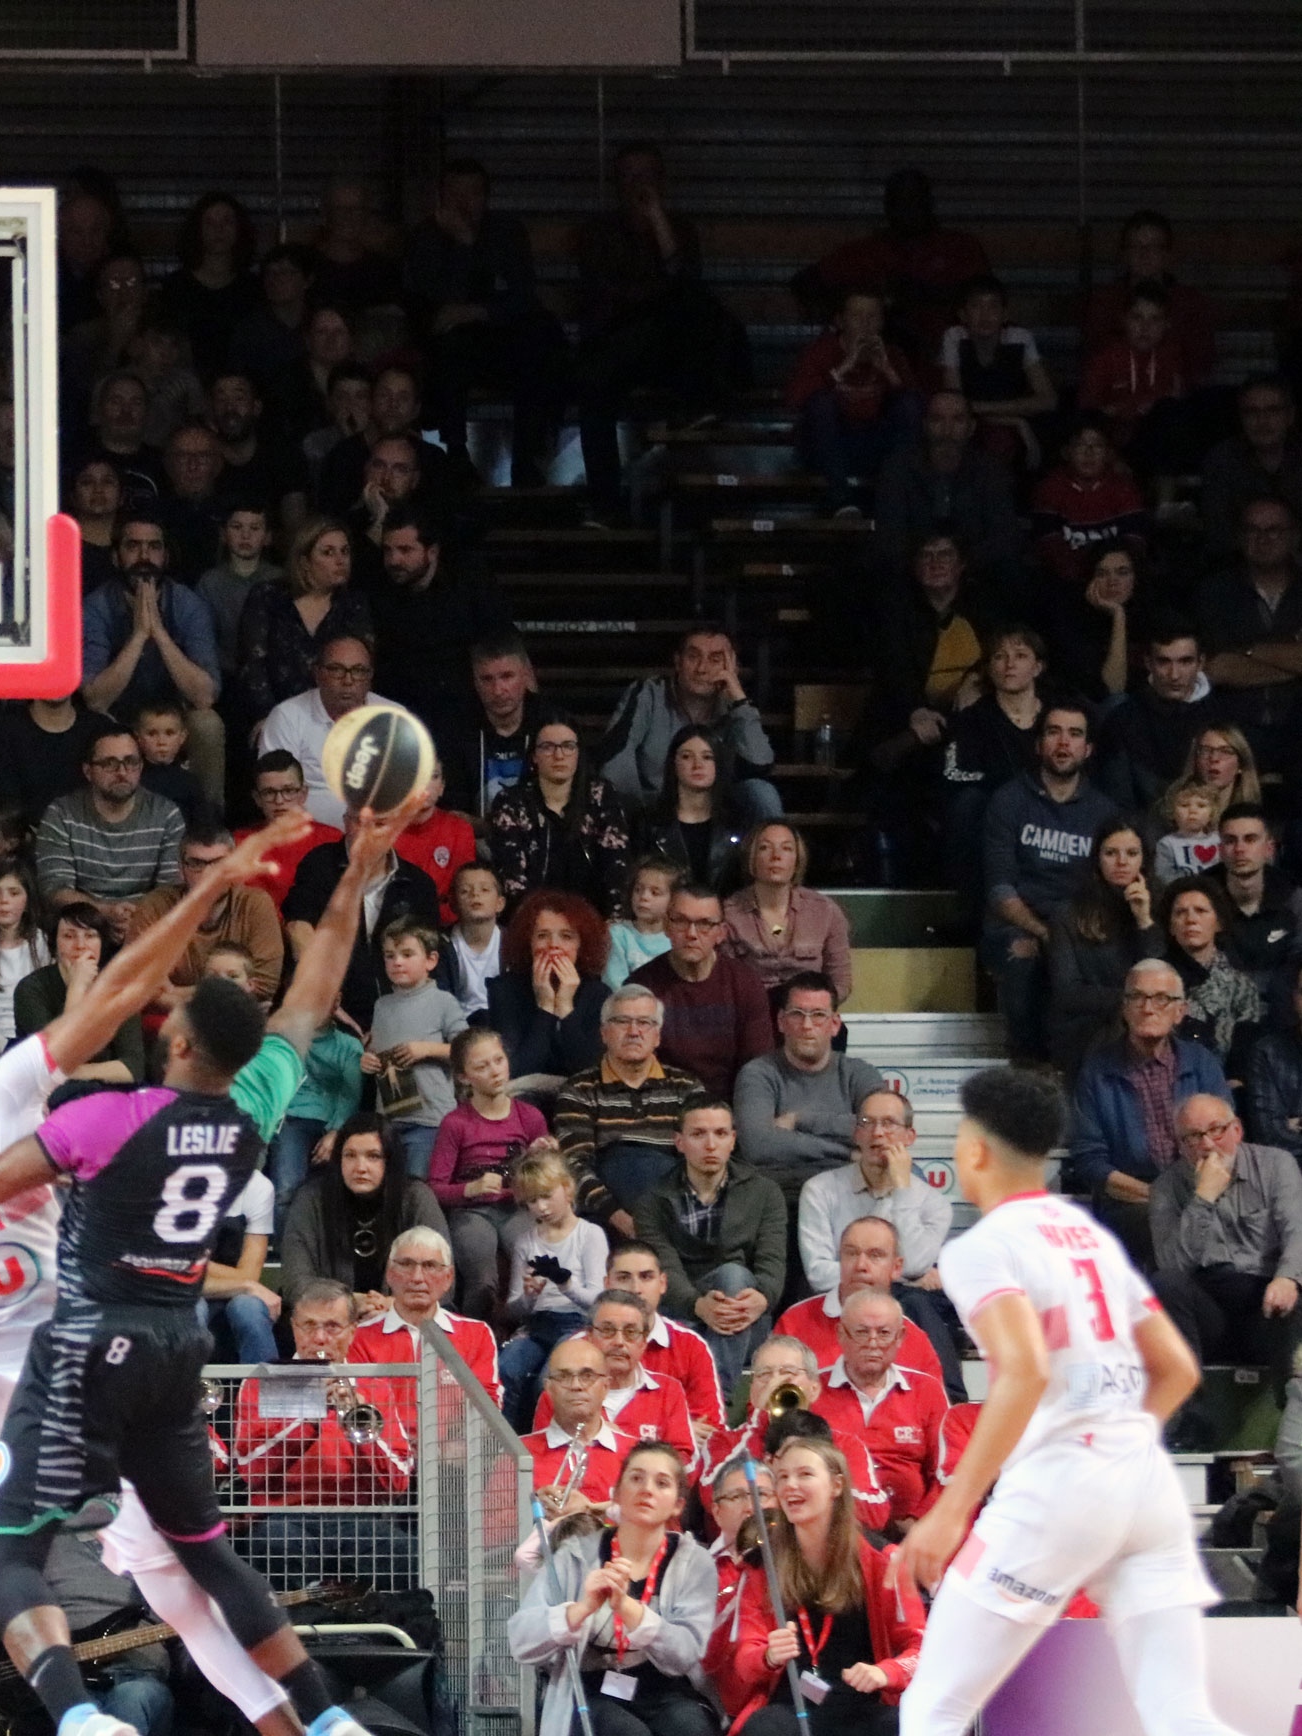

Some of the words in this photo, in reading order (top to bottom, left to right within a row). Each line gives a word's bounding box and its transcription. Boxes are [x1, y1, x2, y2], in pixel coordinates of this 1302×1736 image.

[346, 736, 380, 790] Jeep
[1020, 823, 1092, 857] CAMDEN
[167, 1125, 241, 1157] LESLIE
[928, 1171, 946, 1188] U
[153, 1164, 228, 1243] 8
[105, 1336, 132, 1365] 8
